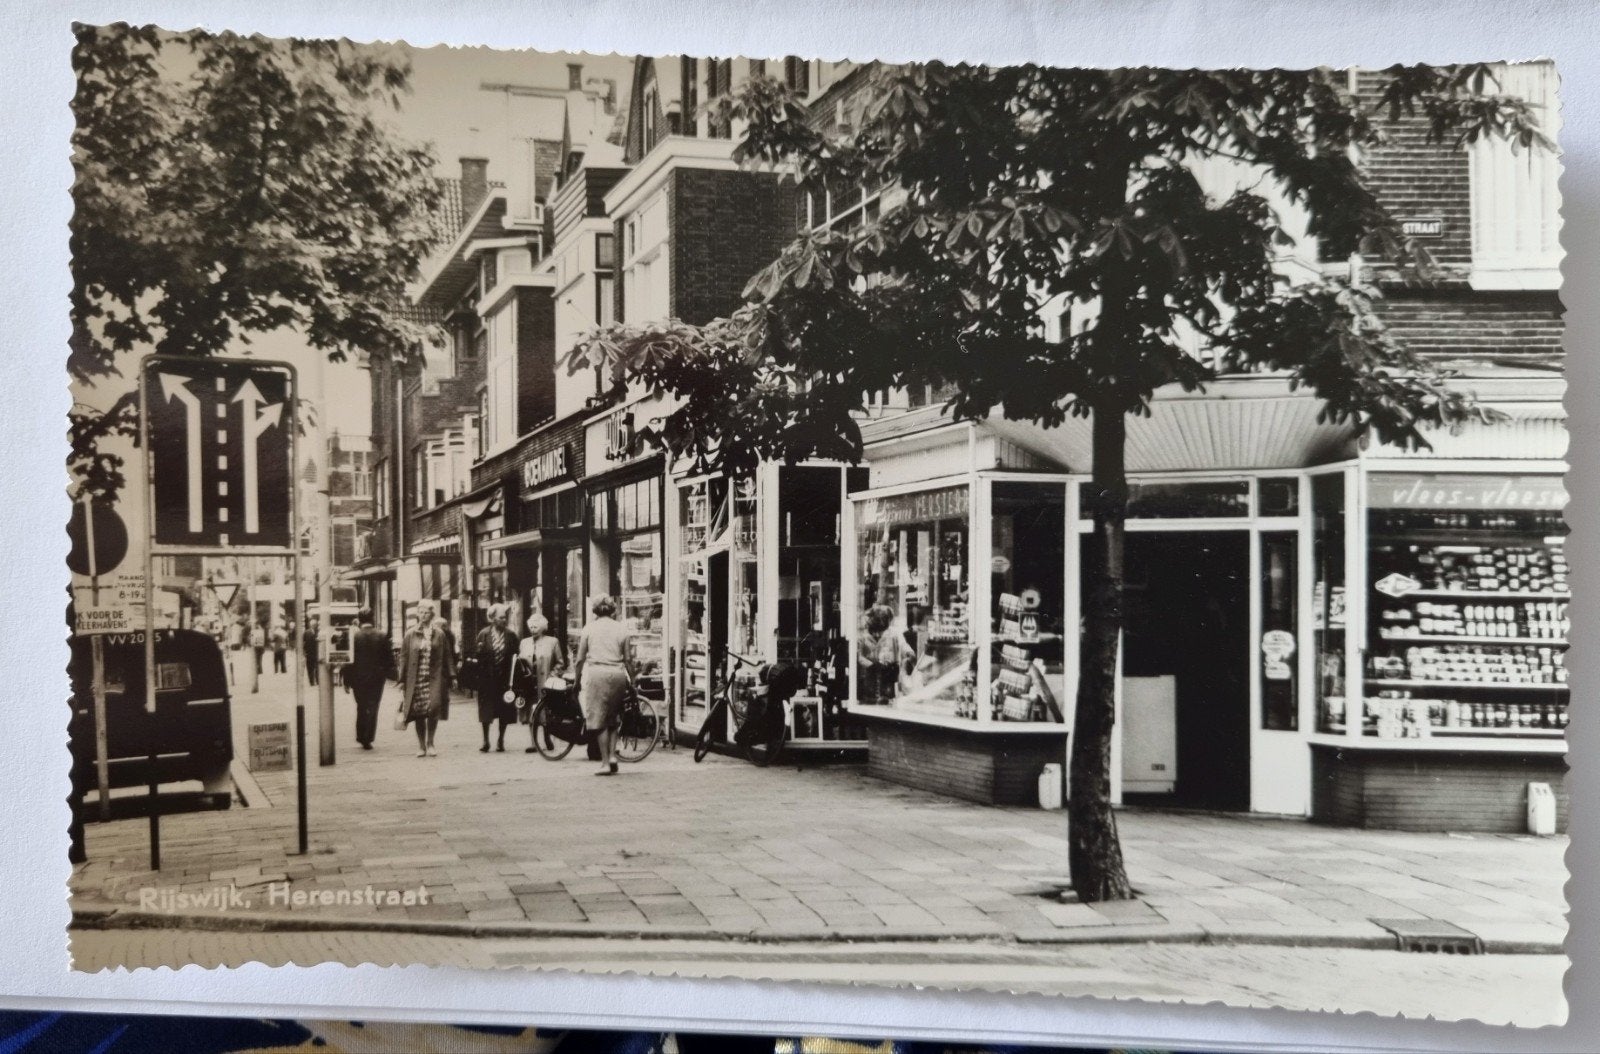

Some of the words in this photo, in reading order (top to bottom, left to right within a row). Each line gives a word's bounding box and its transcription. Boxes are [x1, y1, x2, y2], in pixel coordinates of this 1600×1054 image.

[1402, 222, 1440, 234] STRAAT
[86, 610, 110, 620] VOOR
[112, 609, 124, 619] DE
